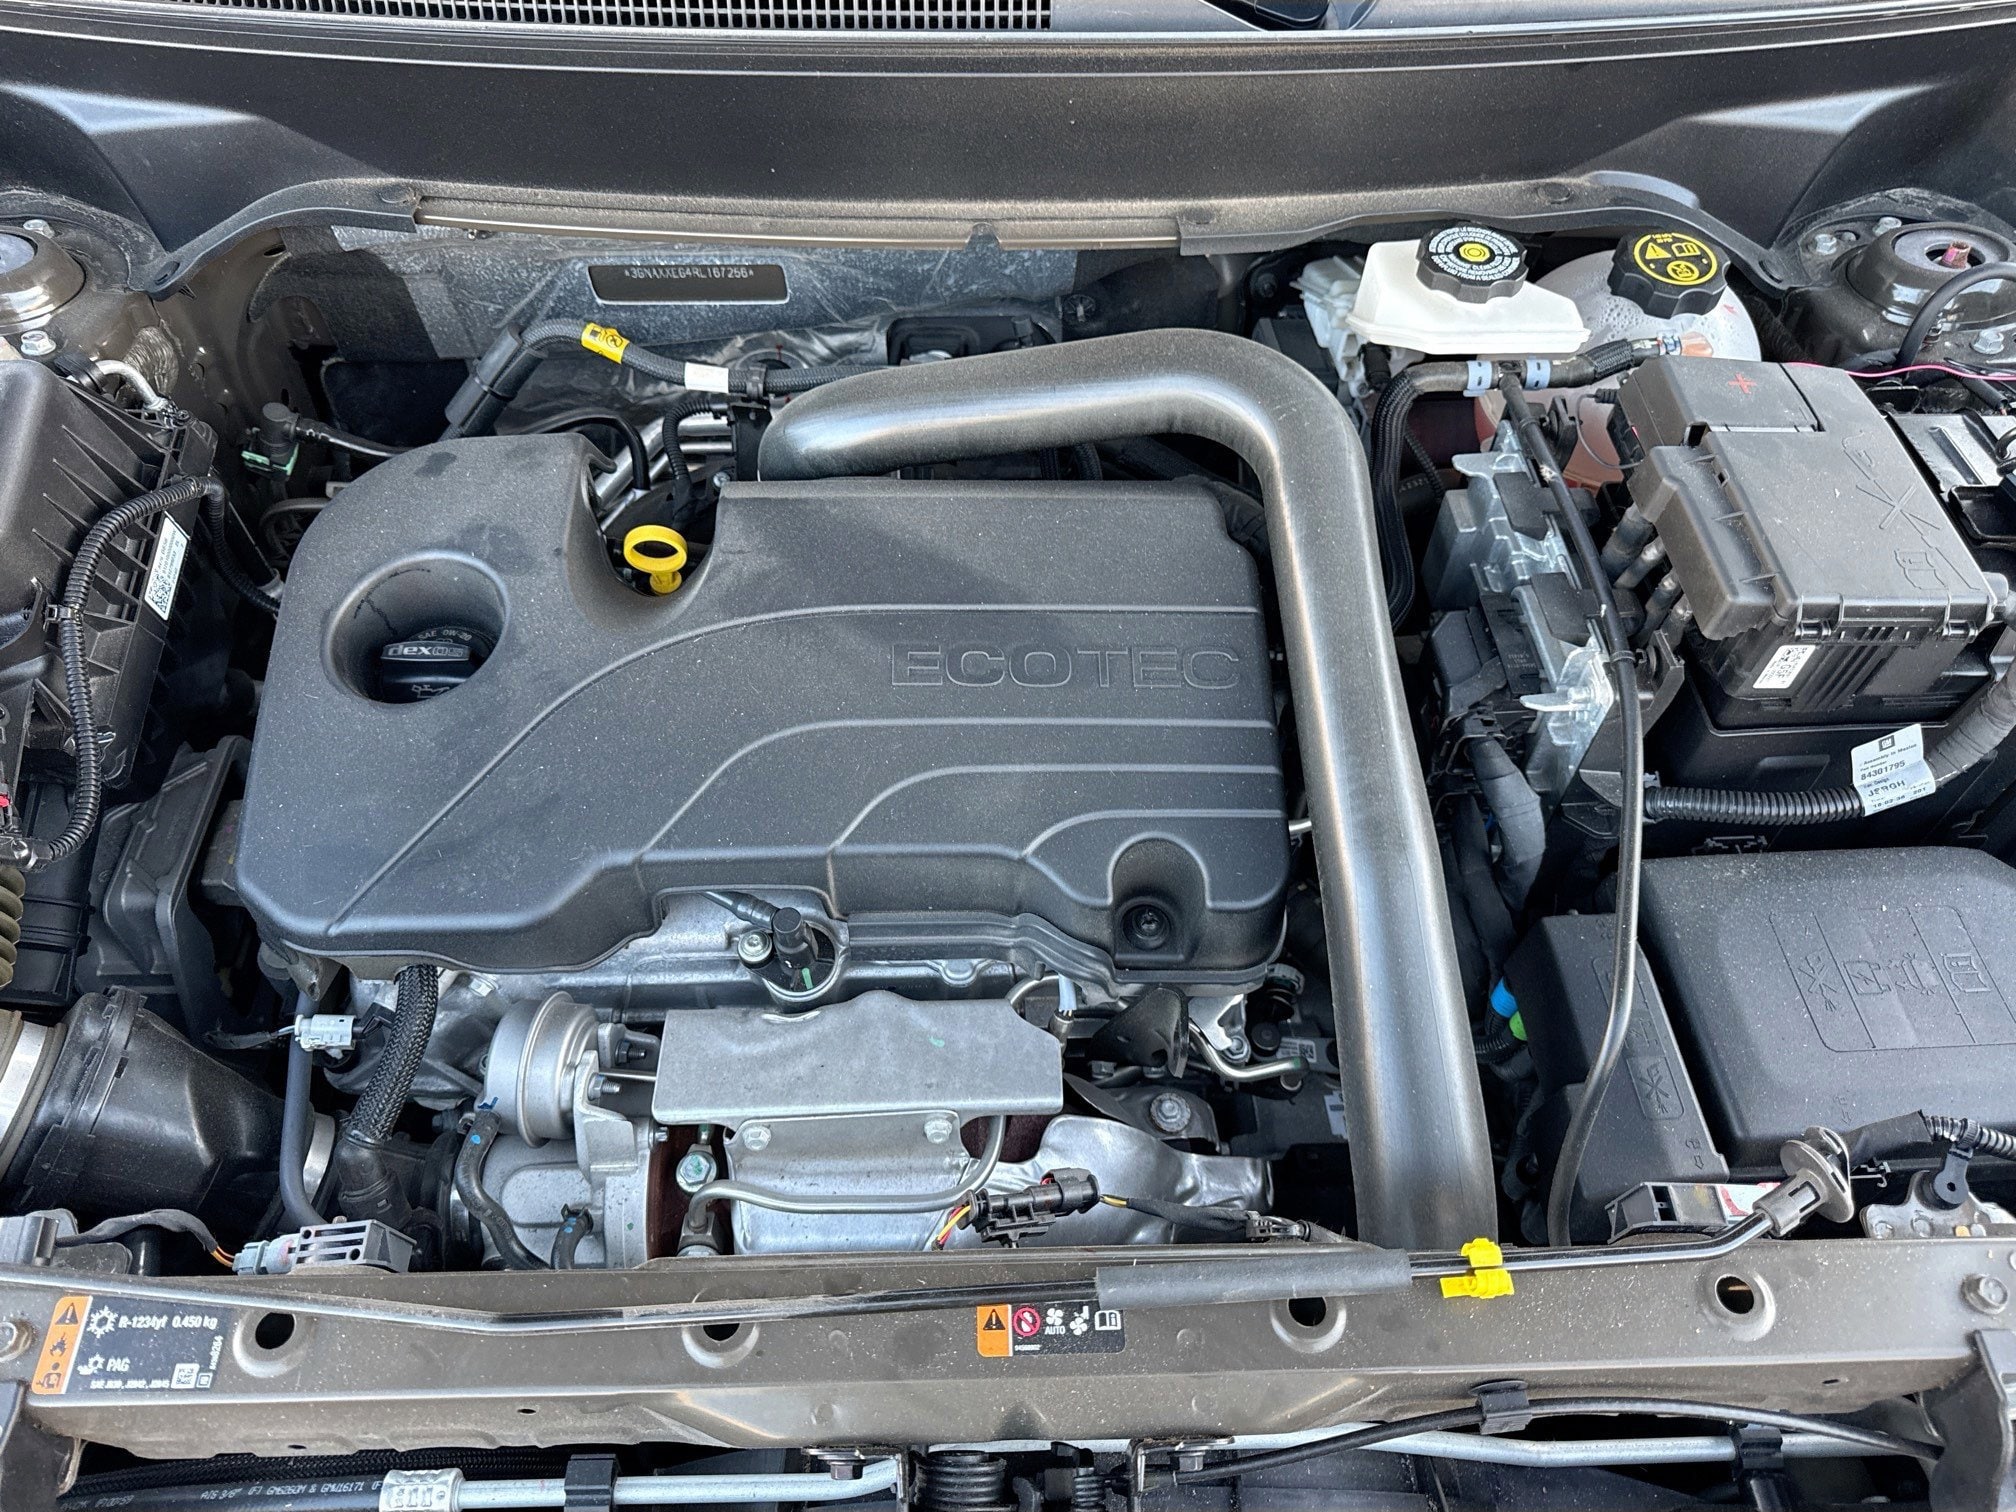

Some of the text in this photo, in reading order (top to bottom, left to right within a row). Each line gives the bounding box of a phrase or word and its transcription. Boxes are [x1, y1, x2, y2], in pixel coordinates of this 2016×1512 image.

[442, 629, 473, 641] 0W-20
[891, 645, 1241, 689] ECOTEC
[1860, 760, 1906, 781] 84301795
[118, 1315, 219, 1330] R-1234yf 0.450 kg
[1044, 1326, 1066, 1335] AUTO
[106, 1358, 131, 1373] PAG
[308, 1484, 317, 1493] &
